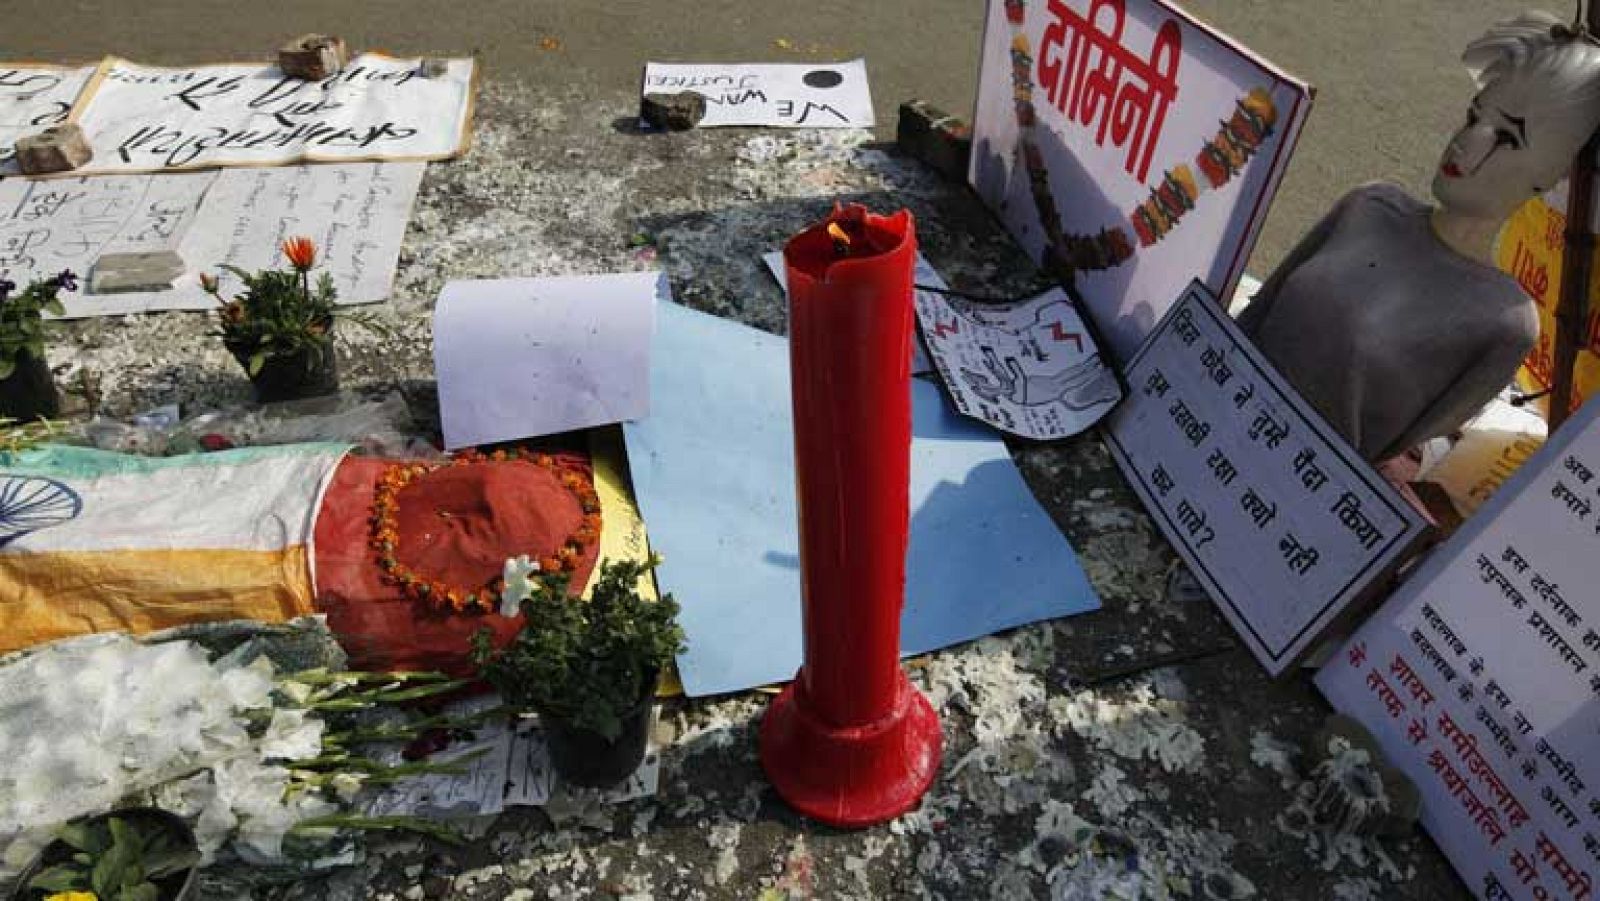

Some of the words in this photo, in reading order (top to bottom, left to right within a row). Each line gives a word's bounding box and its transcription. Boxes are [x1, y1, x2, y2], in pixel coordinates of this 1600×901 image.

[704, 90, 767, 105] WAN
[777, 100, 850, 123] WE
[1037, 0, 1183, 185] दामिनी
[1145, 369, 1170, 398] तुम
[1169, 400, 1210, 448] उसकी
[1152, 464, 1175, 497] कर
[1234, 384, 1253, 407] ने
[1294, 447, 1328, 491] पैदा
[1331, 491, 1383, 548] किया
[1553, 481, 1591, 520] हमारे
[1529, 610, 1587, 673] प्रशासन
